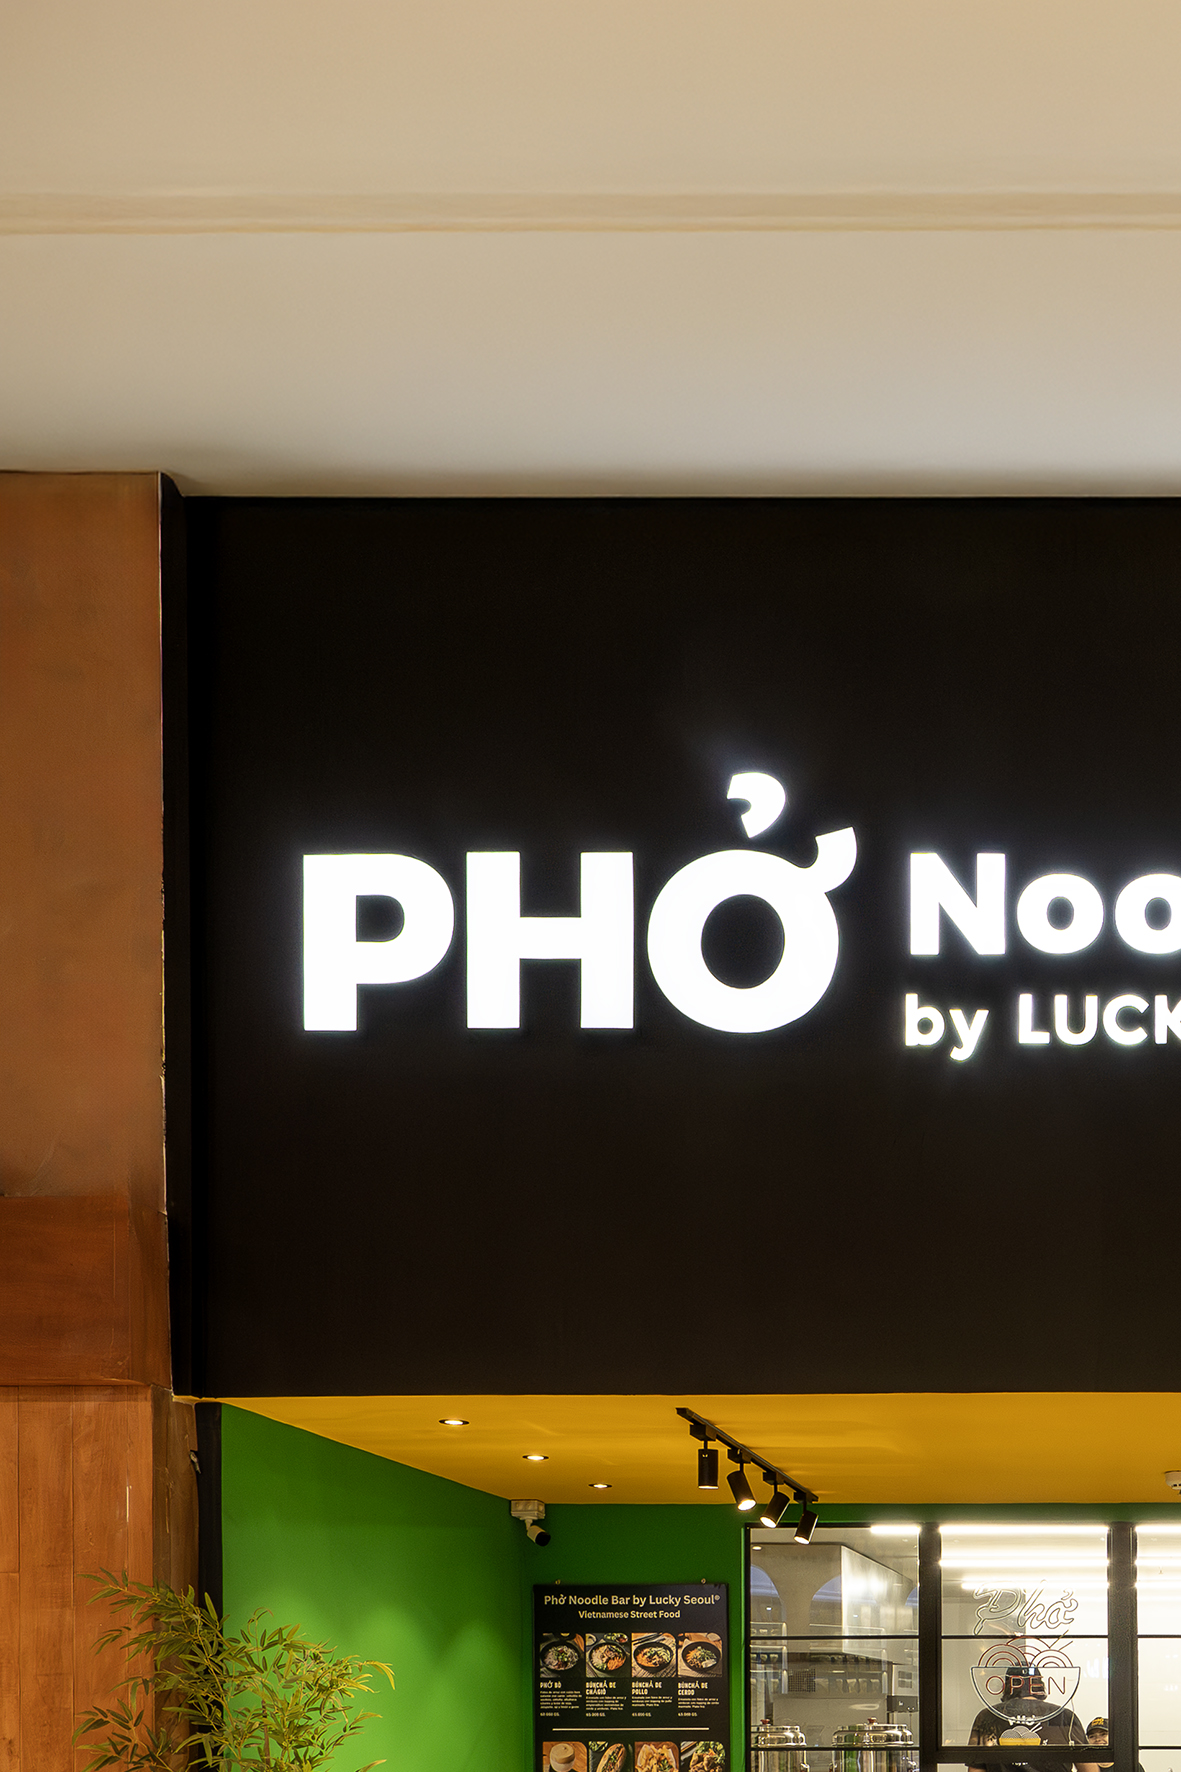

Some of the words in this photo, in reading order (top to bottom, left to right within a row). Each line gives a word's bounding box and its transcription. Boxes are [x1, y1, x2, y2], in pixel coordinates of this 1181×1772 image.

[303, 771, 858, 1034] PHỞ
[904, 992, 990, 1062] by
[569, 1595, 608, 1605] Noodle
[611, 1595, 630, 1605] Bar
[633, 1595, 645, 1607] by
[649, 1594, 681, 1607] Lucky
[579, 1610, 628, 1618] Vietnamese
[630, 1610, 657, 1618] Street
[659, 1610, 680, 1618] Food
[986, 1675, 1065, 1695] OPEN
